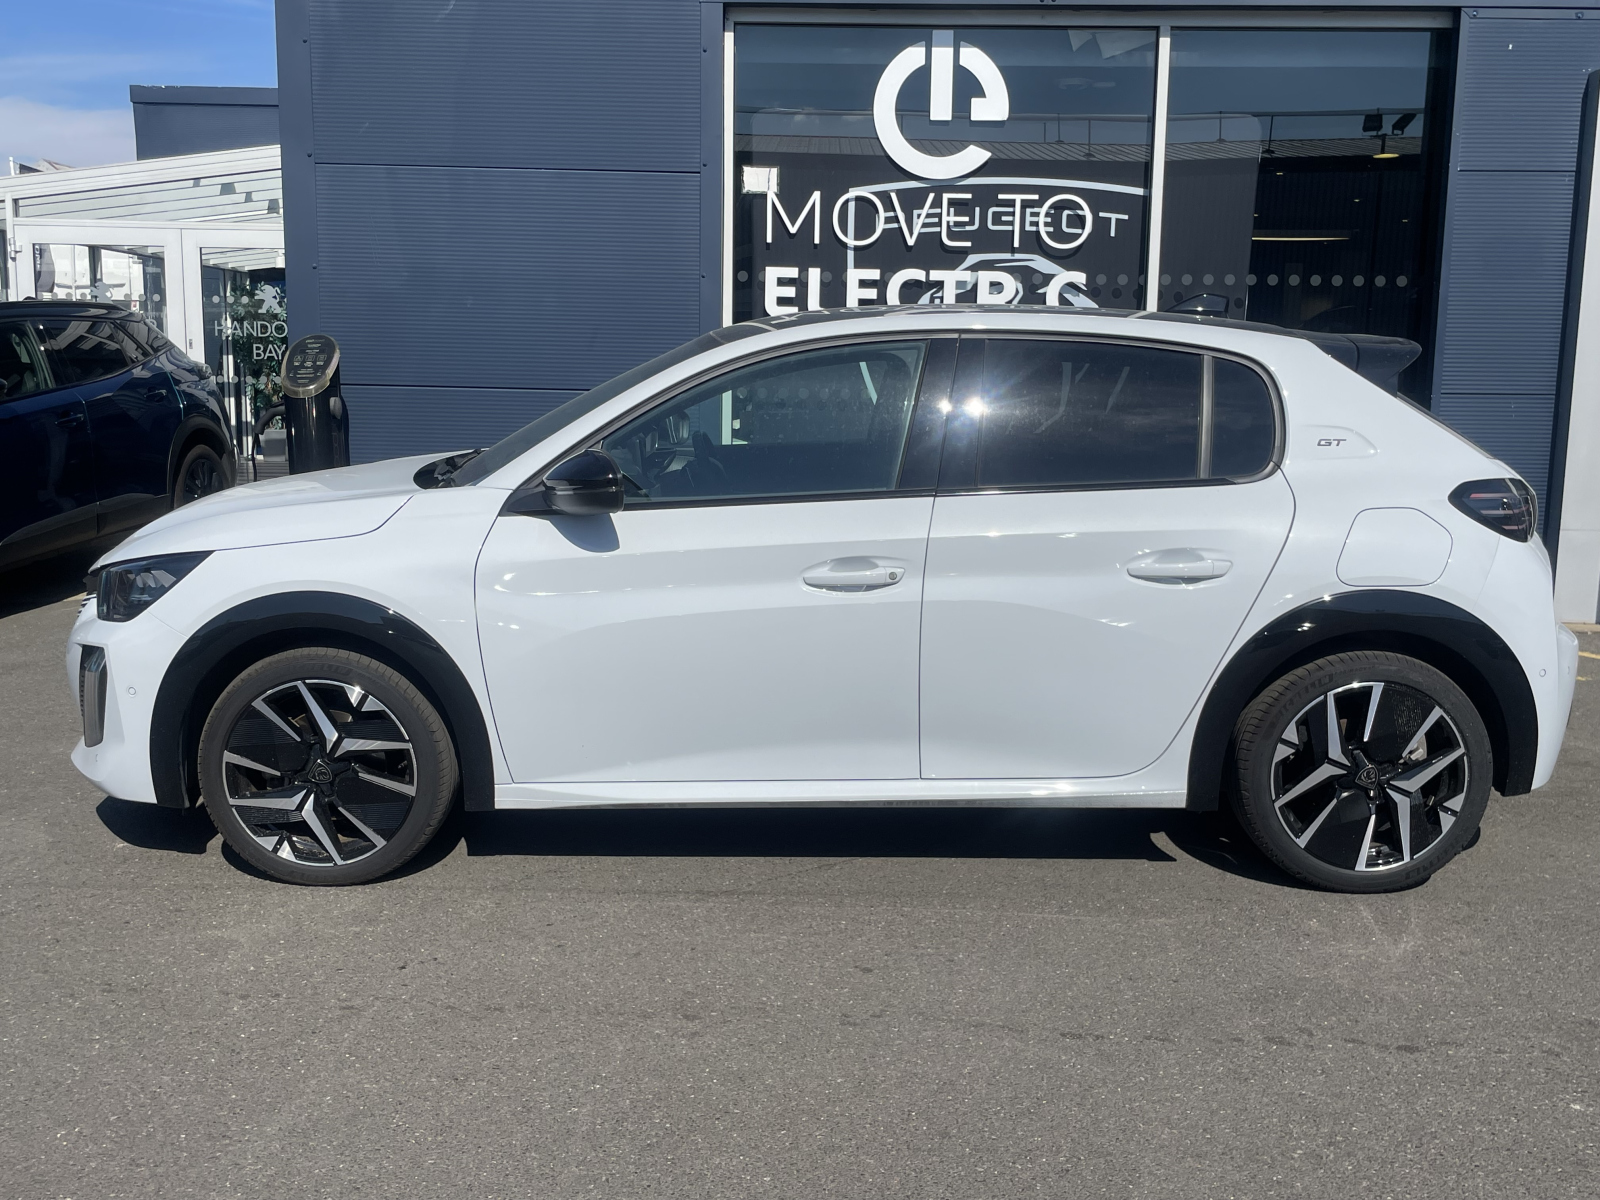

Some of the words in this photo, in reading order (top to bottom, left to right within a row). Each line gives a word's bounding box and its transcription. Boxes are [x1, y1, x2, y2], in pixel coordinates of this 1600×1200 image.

[766, 191, 972, 246] MOVE
[998, 194, 1092, 249] TO
[876, 207, 1128, 238] PEUGEOT
[765, 267, 1086, 316] ELECTRC
[253, 344, 287, 360] BAY
[1317, 439, 1347, 447] GT
